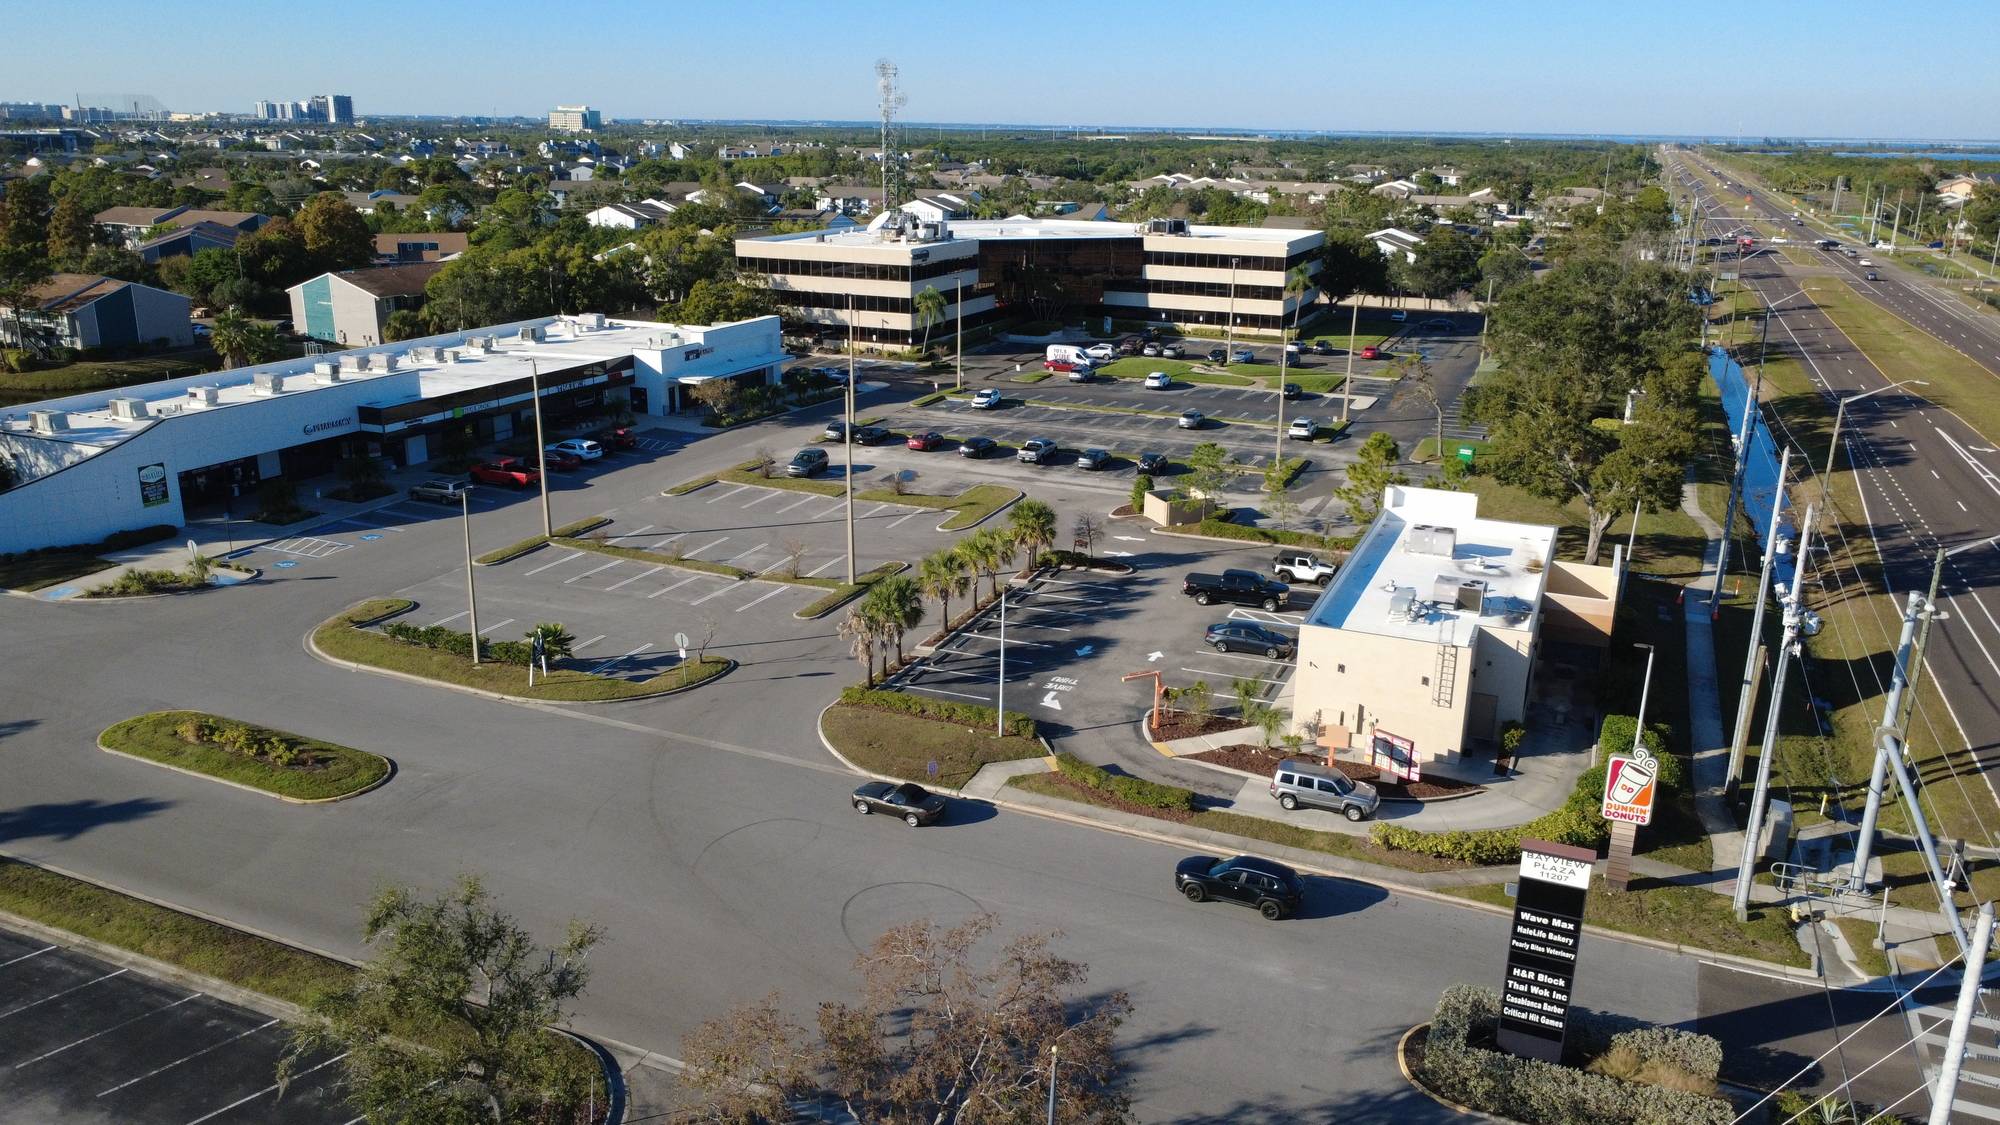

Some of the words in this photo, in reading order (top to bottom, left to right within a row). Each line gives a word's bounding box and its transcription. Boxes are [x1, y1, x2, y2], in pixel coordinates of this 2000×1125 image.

[1042, 682, 1073, 691] DRIVE
[1605, 810, 1646, 823] DONUTS
[1606, 803, 1650, 815] DUNKIN'
[1527, 852, 1586, 869] BAYVIEW
[1534, 862, 1576, 876] PLAZA
[1540, 871, 1569, 881] 11207
[1520, 911, 1549, 925] Wave
[1551, 918, 1575, 930] Max
[1548, 932, 1574, 946] Bakery
[1511, 939, 1530, 950] Pearly
[1546, 947, 1576, 960] Veterinary
[1512, 967, 1535, 980] H&R
[1537, 973, 1566, 987] Block
[1507, 980, 1528, 992] Thai
[1530, 985, 1550, 997] Wok
[1552, 990, 1568, 1002] Inc
[1505, 993, 1542, 1010] Casablanca
[1542, 1002, 1565, 1015] Barber
[1503, 1006, 1528, 1020] Critical
[1528, 1012, 1540, 1023] Hit
[1540, 1016, 1564, 1029] Games
